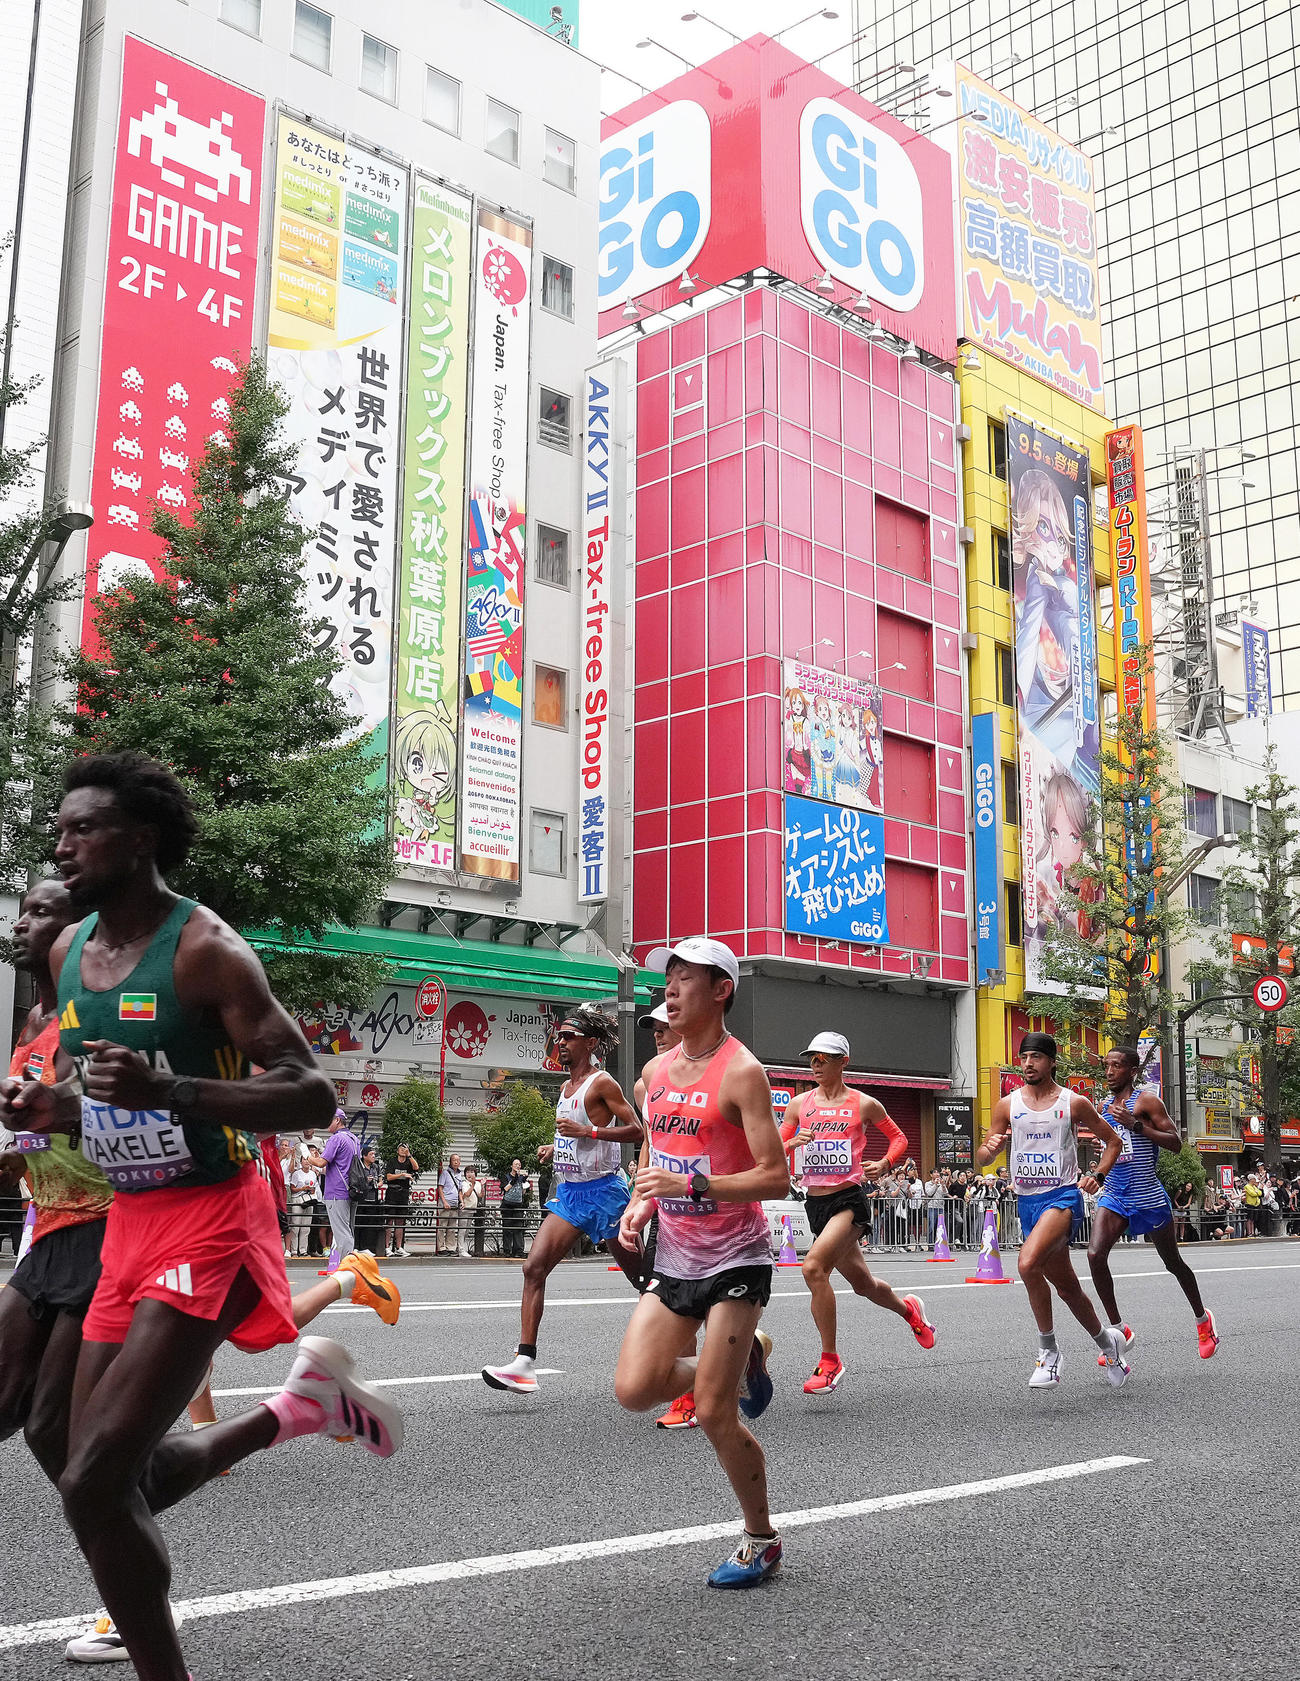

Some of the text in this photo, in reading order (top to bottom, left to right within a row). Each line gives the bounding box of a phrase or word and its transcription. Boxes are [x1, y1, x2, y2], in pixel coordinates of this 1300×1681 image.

[283, 171, 332, 197] medimix
[964, 129, 1091, 251] 激安販売
[345, 197, 392, 223] medimix
[128, 183, 243, 279] GAME
[281, 221, 329, 247] medimix
[344, 246, 390, 272] medimix
[965, 202, 1091, 311] 高額買取
[118, 255, 243, 328] 2F 4F
[279, 271, 329, 296] medimix
[490, 314, 509, 499] Japan. Tax-free Shop
[586, 375, 610, 483] AKKY
[349, 346, 390, 666] 世界で愛される
[585, 515, 609, 684] Tax-free
[471, 727, 516, 745] Welcome
[582, 688, 608, 790] Shop
[468, 777, 516, 793] Bienvenidos
[975, 763, 994, 828] GiGO
[468, 826, 514, 842] Bienvenue
[785, 808, 861, 859] ゲームの
[470, 841, 509, 856] accueillir
[785, 829, 876, 899] オアシスに
[850, 920, 882, 938] GiGO
[1260, 985, 1280, 1002] 50
[506, 1010, 545, 1027] Japan.
[501, 1028, 545, 1043] Tax-free
[517, 1045, 545, 1062] Shop
[771, 1092, 790, 1105] iGO
[651, 1113, 702, 1136] JAPAN
[809, 1121, 849, 1132] JAPAN
[1026, 1132, 1052, 1140] ITALIA
[85, 1129, 181, 1162] TAKELE
[814, 1140, 848, 1151] TDK
[1023, 1152, 1056, 1163] TDK
[658, 1154, 703, 1175] TDK
[804, 1154, 849, 1166] KONDO
[1016, 1165, 1058, 1177] AOUANI
